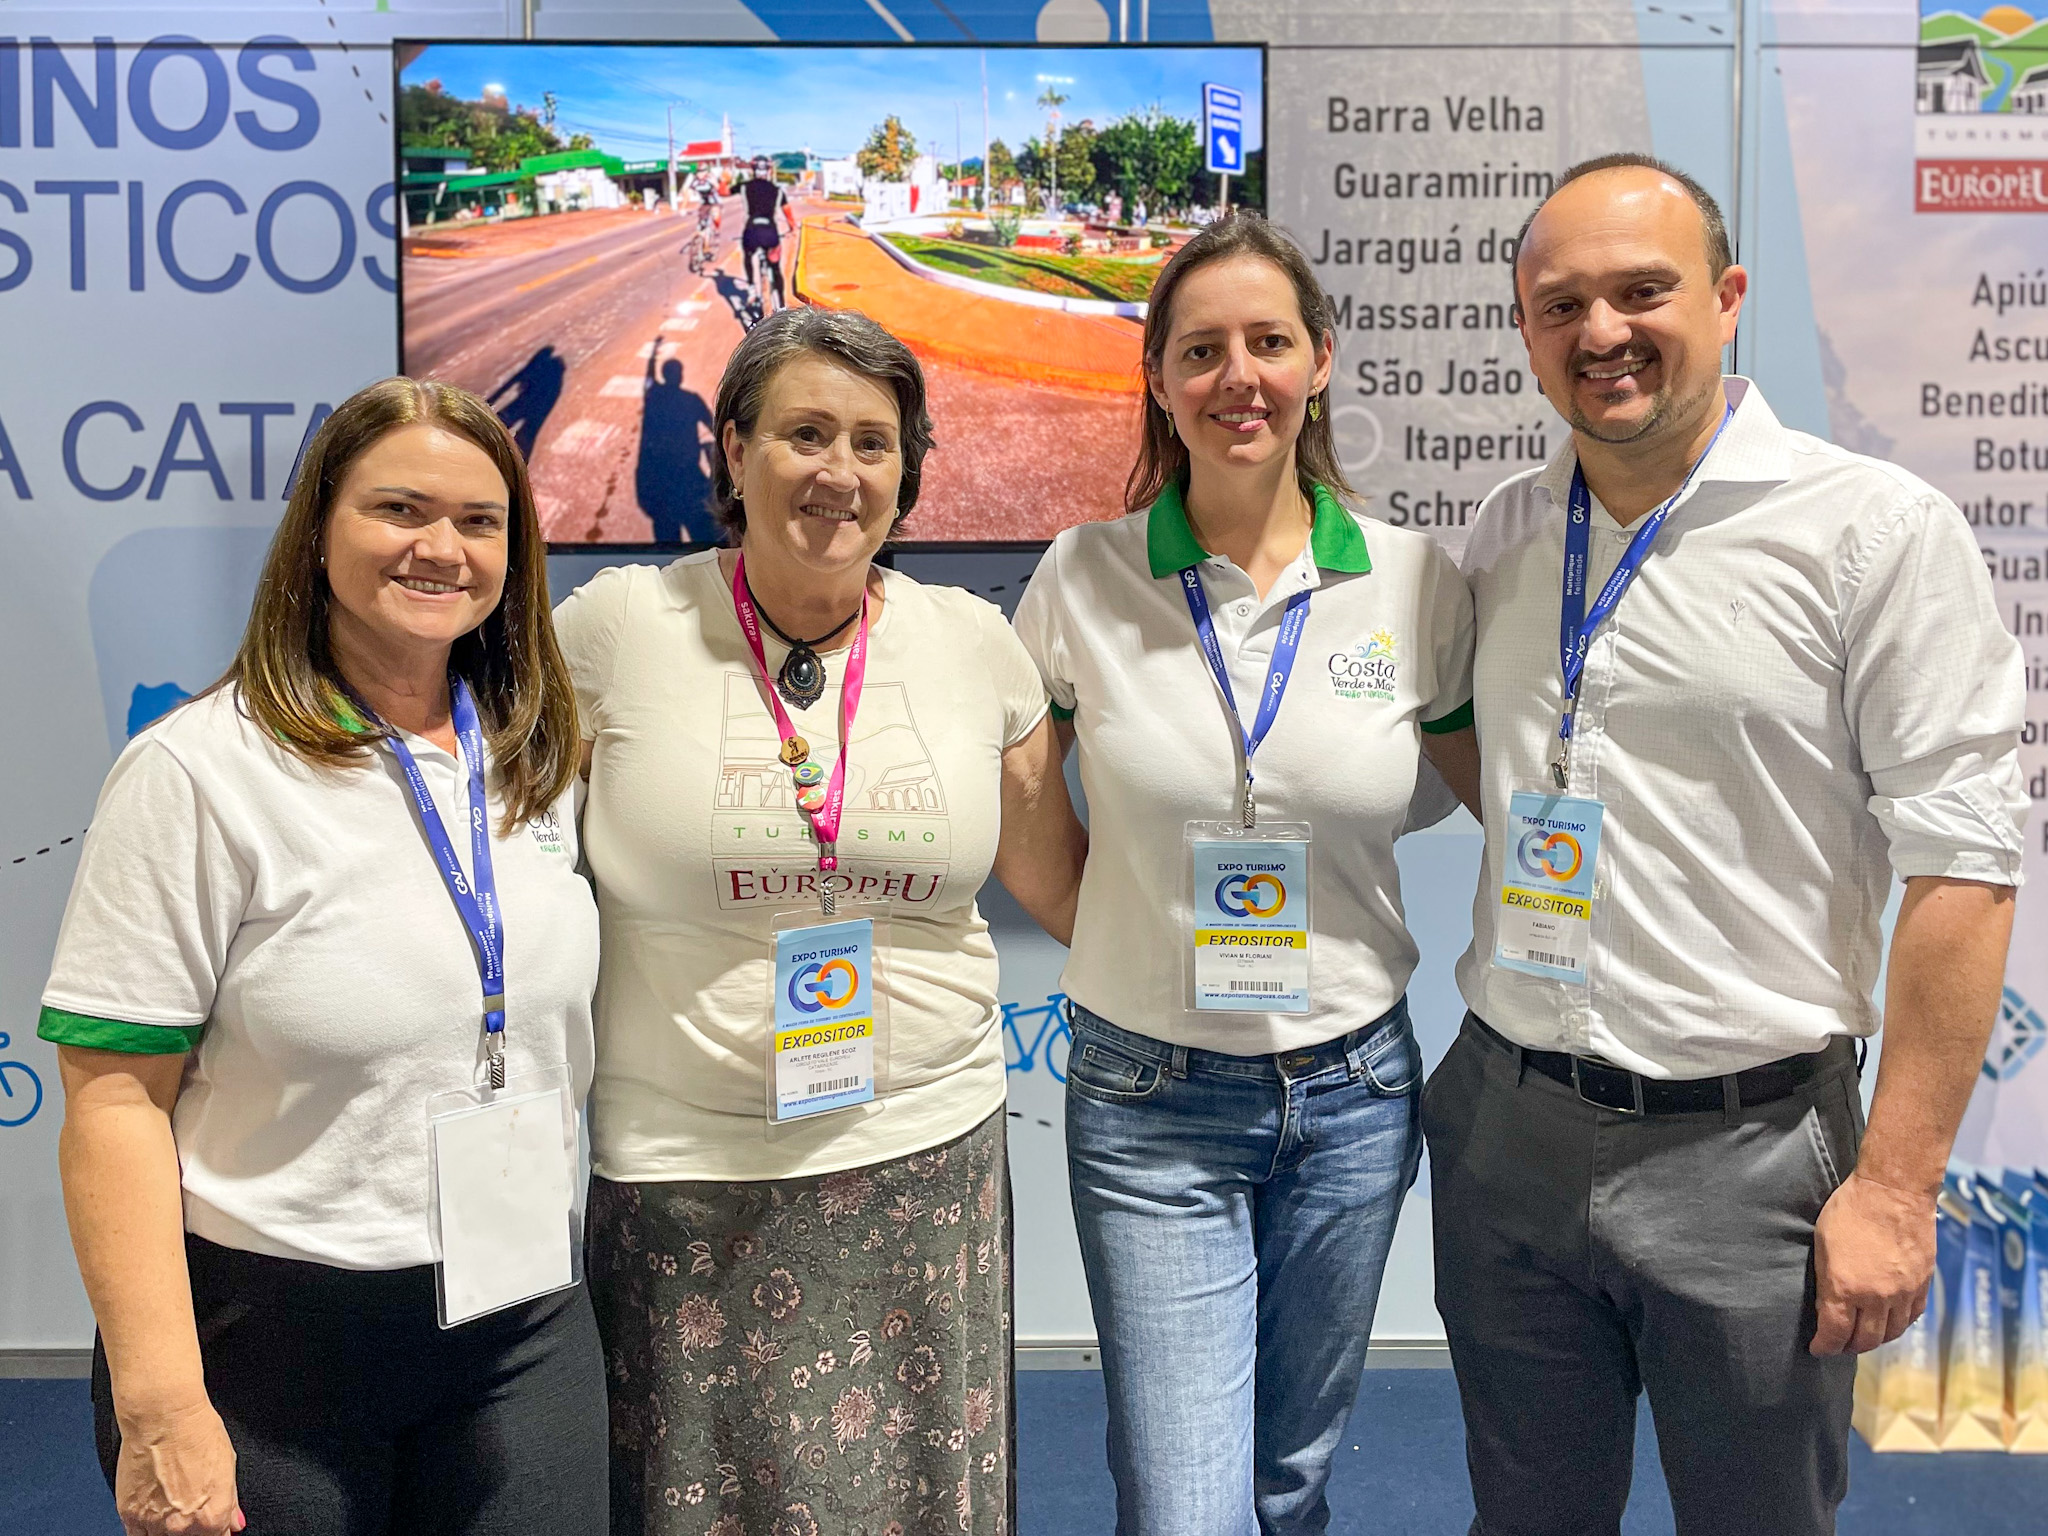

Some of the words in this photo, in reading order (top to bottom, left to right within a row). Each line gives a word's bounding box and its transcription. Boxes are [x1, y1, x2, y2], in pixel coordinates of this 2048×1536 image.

[1328, 97, 1430, 133] Barra
[1444, 96, 1545, 133] Velha
[1334, 163, 1555, 200] Guaramirim
[1313, 224, 1462, 274] Jaraguá
[1477, 228, 1516, 264] do
[1971, 268, 2048, 316] Apiú
[1357, 358, 1423, 397] São
[1438, 358, 1523, 396] João
[1405, 420, 1546, 471] Itaperiú
[1981, 548, 2048, 581] Gua
[741, 601, 757, 638] sakura
[1328, 653, 1396, 681] Costa
[1331, 676, 1366, 690] Verde
[1374, 677, 1396, 692] Mar
[532, 829, 561, 843] Verde
[733, 826, 935, 843] TURSMO
[1521, 816, 1545, 827] EXPO
[1547, 819, 1586, 832] TURISMO
[1217, 863, 1243, 871] EXPO
[1246, 863, 1286, 872] TURISMO
[725, 870, 942, 902] EUROPEU
[1506, 892, 1584, 917] EXPOSITOR
[1532, 921, 1556, 931] FABIANO
[791, 950, 818, 964] EXPO
[819, 944, 859, 959] TURISMO
[1209, 935, 1294, 948] EXPOSITOR
[783, 1024, 866, 1051] EXPOSITOR
[790, 1054, 812, 1063] ARLETE
[812, 1050, 841, 1060] REGILENE
[842, 1046, 857, 1055] SCOZ
